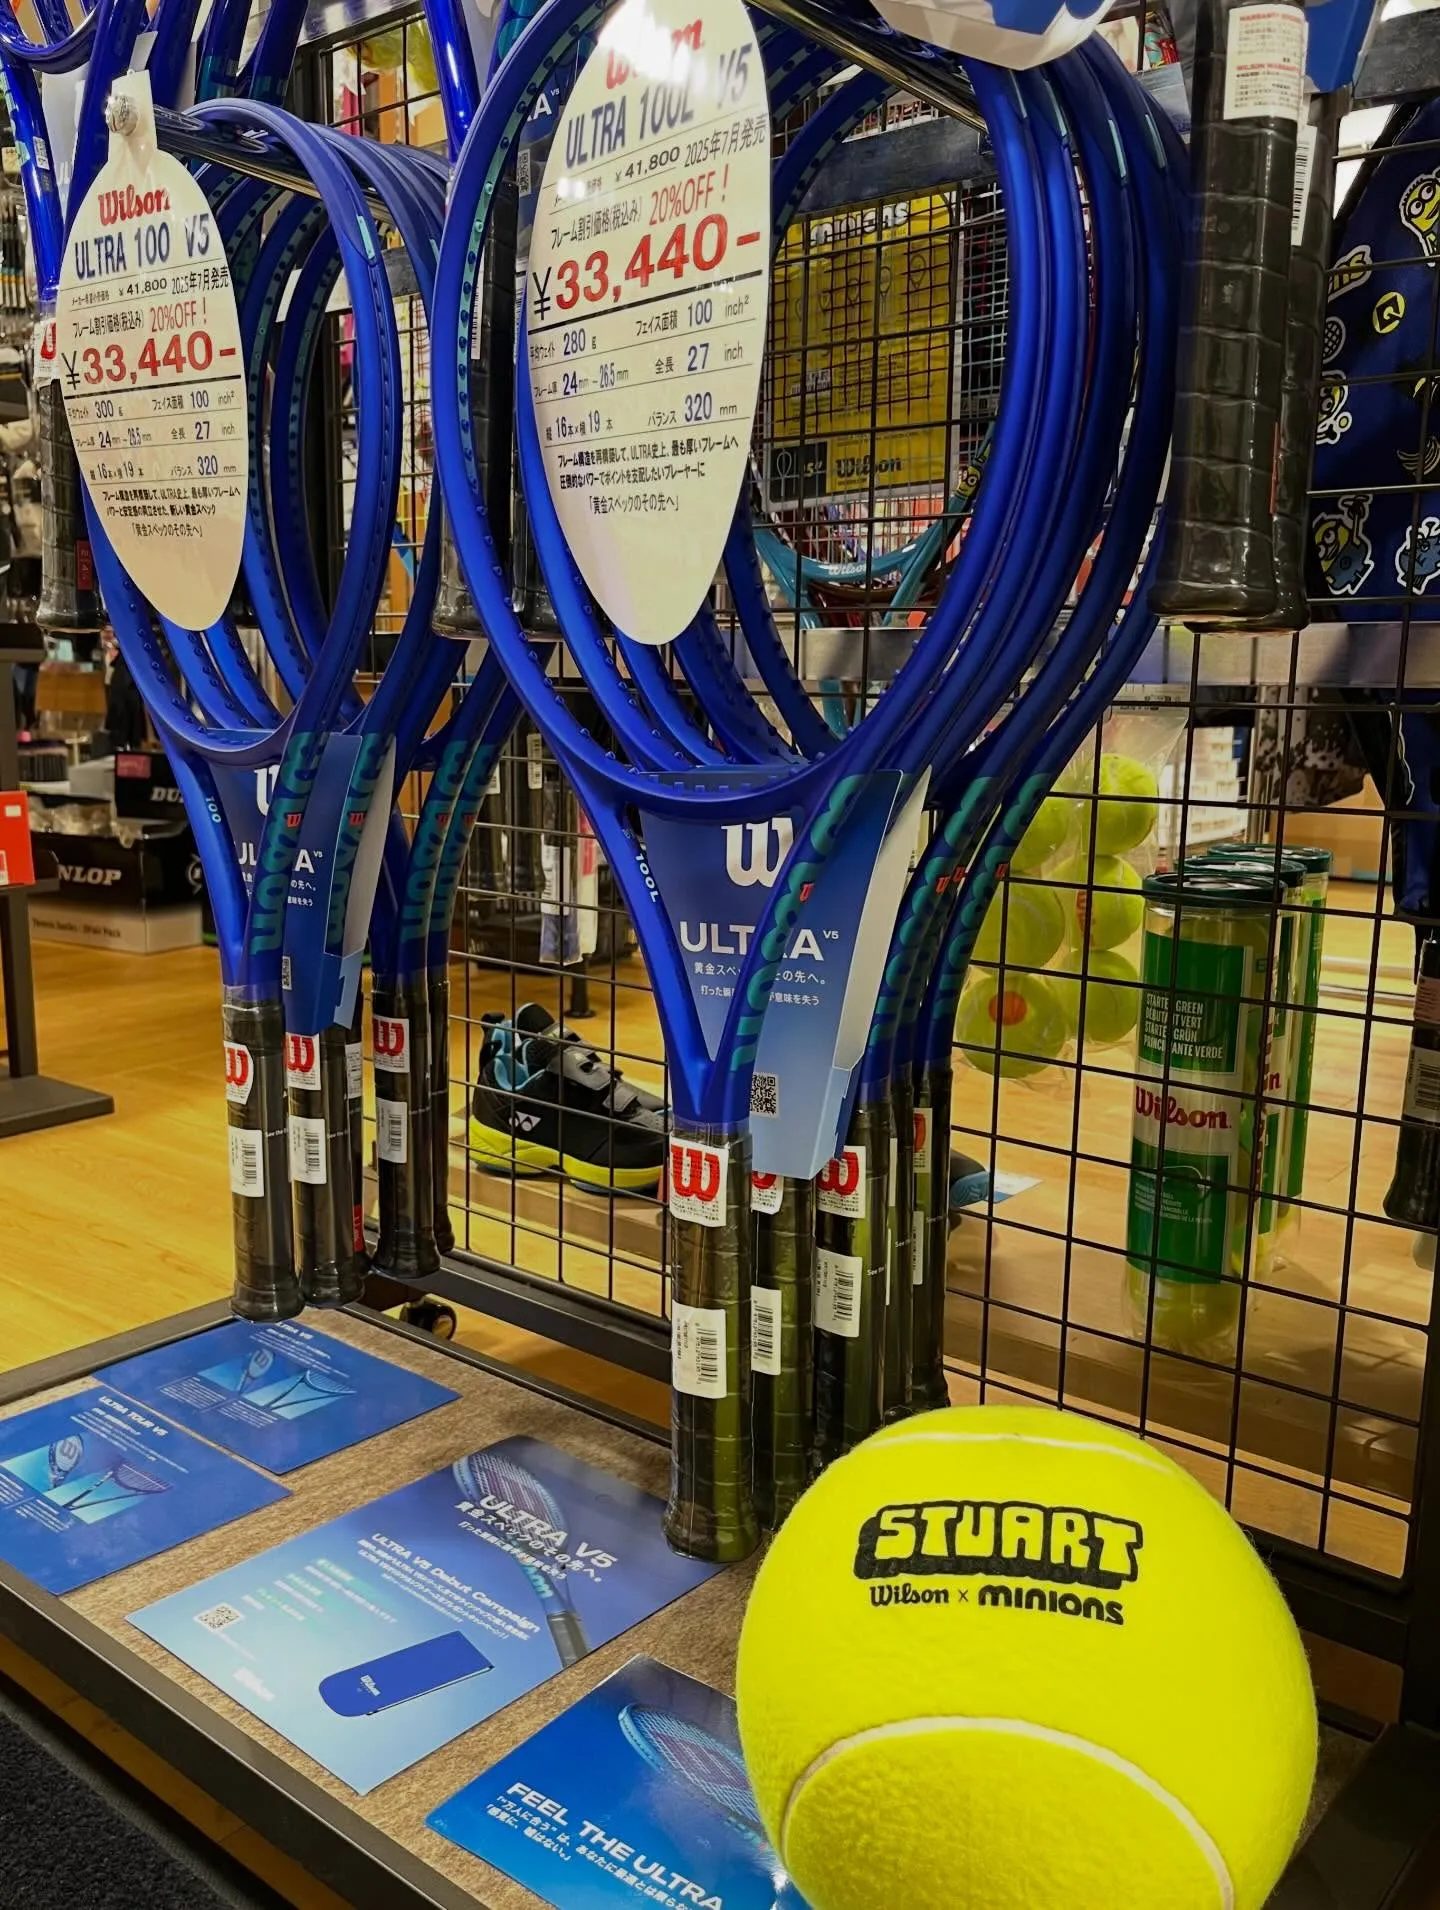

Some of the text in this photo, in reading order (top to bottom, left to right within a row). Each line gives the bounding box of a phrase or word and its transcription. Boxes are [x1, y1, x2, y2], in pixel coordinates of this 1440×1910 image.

[566, 96, 627, 169] ULTRA
[718, 43, 753, 109] V5
[684, 113, 767, 168] 2025年7月発売
[98, 184, 170, 226] Wilson
[75, 212, 209, 280] ULTRA 100 V5
[563, 328, 586, 356] 280
[636, 310, 678, 337] フェイス面積
[688, 298, 712, 327] 100
[655, 357, 674, 375] 全長
[687, 343, 709, 371] 27
[724, 341, 743, 361] inch
[94, 399, 114, 419] 300
[190, 390, 209, 408] 100
[684, 391, 712, 424] 320
[719, 404, 738, 416] mm
[195, 421, 210, 440] 27
[222, 425, 235, 435] inch
[197, 455, 218, 476] 320
[223, 465, 236, 473] mm
[206, 796, 222, 823] 100
[635, 852, 661, 903] 100L
[680, 921, 839, 961] ULTA V5
[1146, 993, 1204, 1015] STARTE GREEN
[1180, 1014, 1202, 1029] VERT
[1144, 1021, 1198, 1042] STARTE GRÜN
[1195, 1046, 1223, 1059] VERDE
[1136, 1086, 1228, 1129] Wilson
[480, 1494, 618, 1569] ULTRA V5
[855, 1500, 1143, 1590] STUART
[372, 1533, 412, 1559] ULTRA
[412, 1555, 433, 1571] V5
[431, 1567, 473, 1594] Debut
[472, 1591, 541, 1634] Campaign
[870, 1583, 949, 1607] Wilson
[506, 1781, 722, 1910] FEEL THE ULTRA
